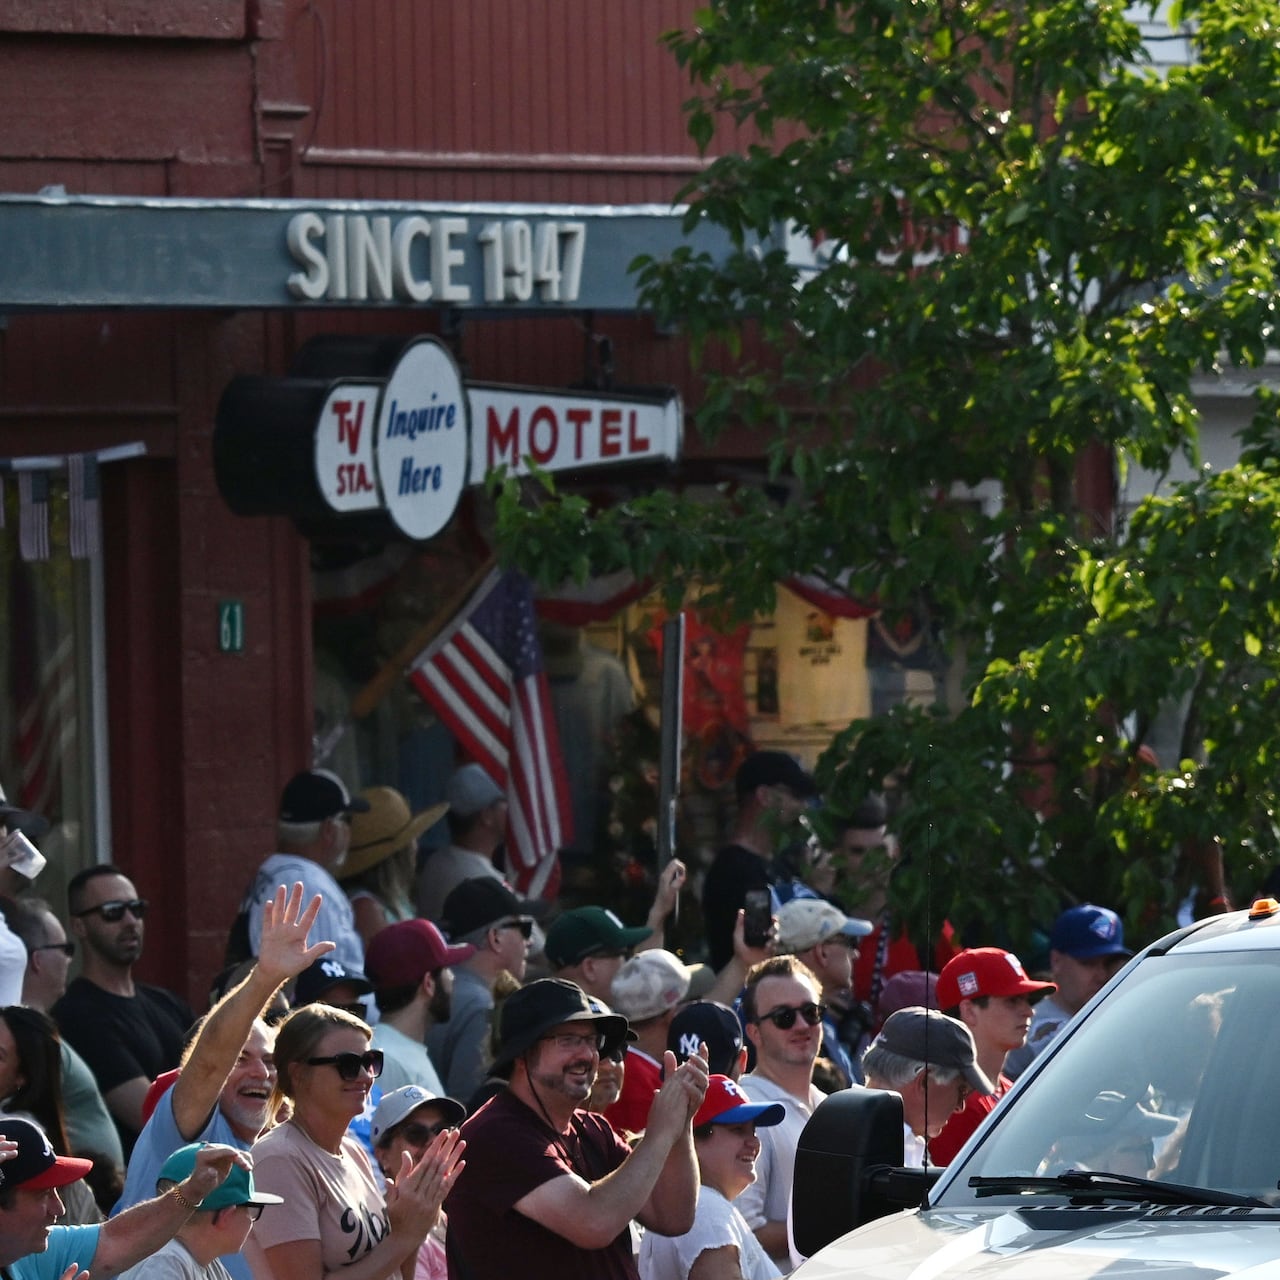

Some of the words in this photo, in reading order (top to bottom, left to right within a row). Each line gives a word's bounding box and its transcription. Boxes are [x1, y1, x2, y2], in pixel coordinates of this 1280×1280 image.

[287, 212, 471, 301] SINCE
[478, 219, 586, 301] 1947
[333, 401, 366, 455] TV
[386, 393, 456, 440] Inquire
[486, 404, 650, 468] MOTEL
[336, 462, 374, 496] STA.
[398, 457, 441, 496] Here
